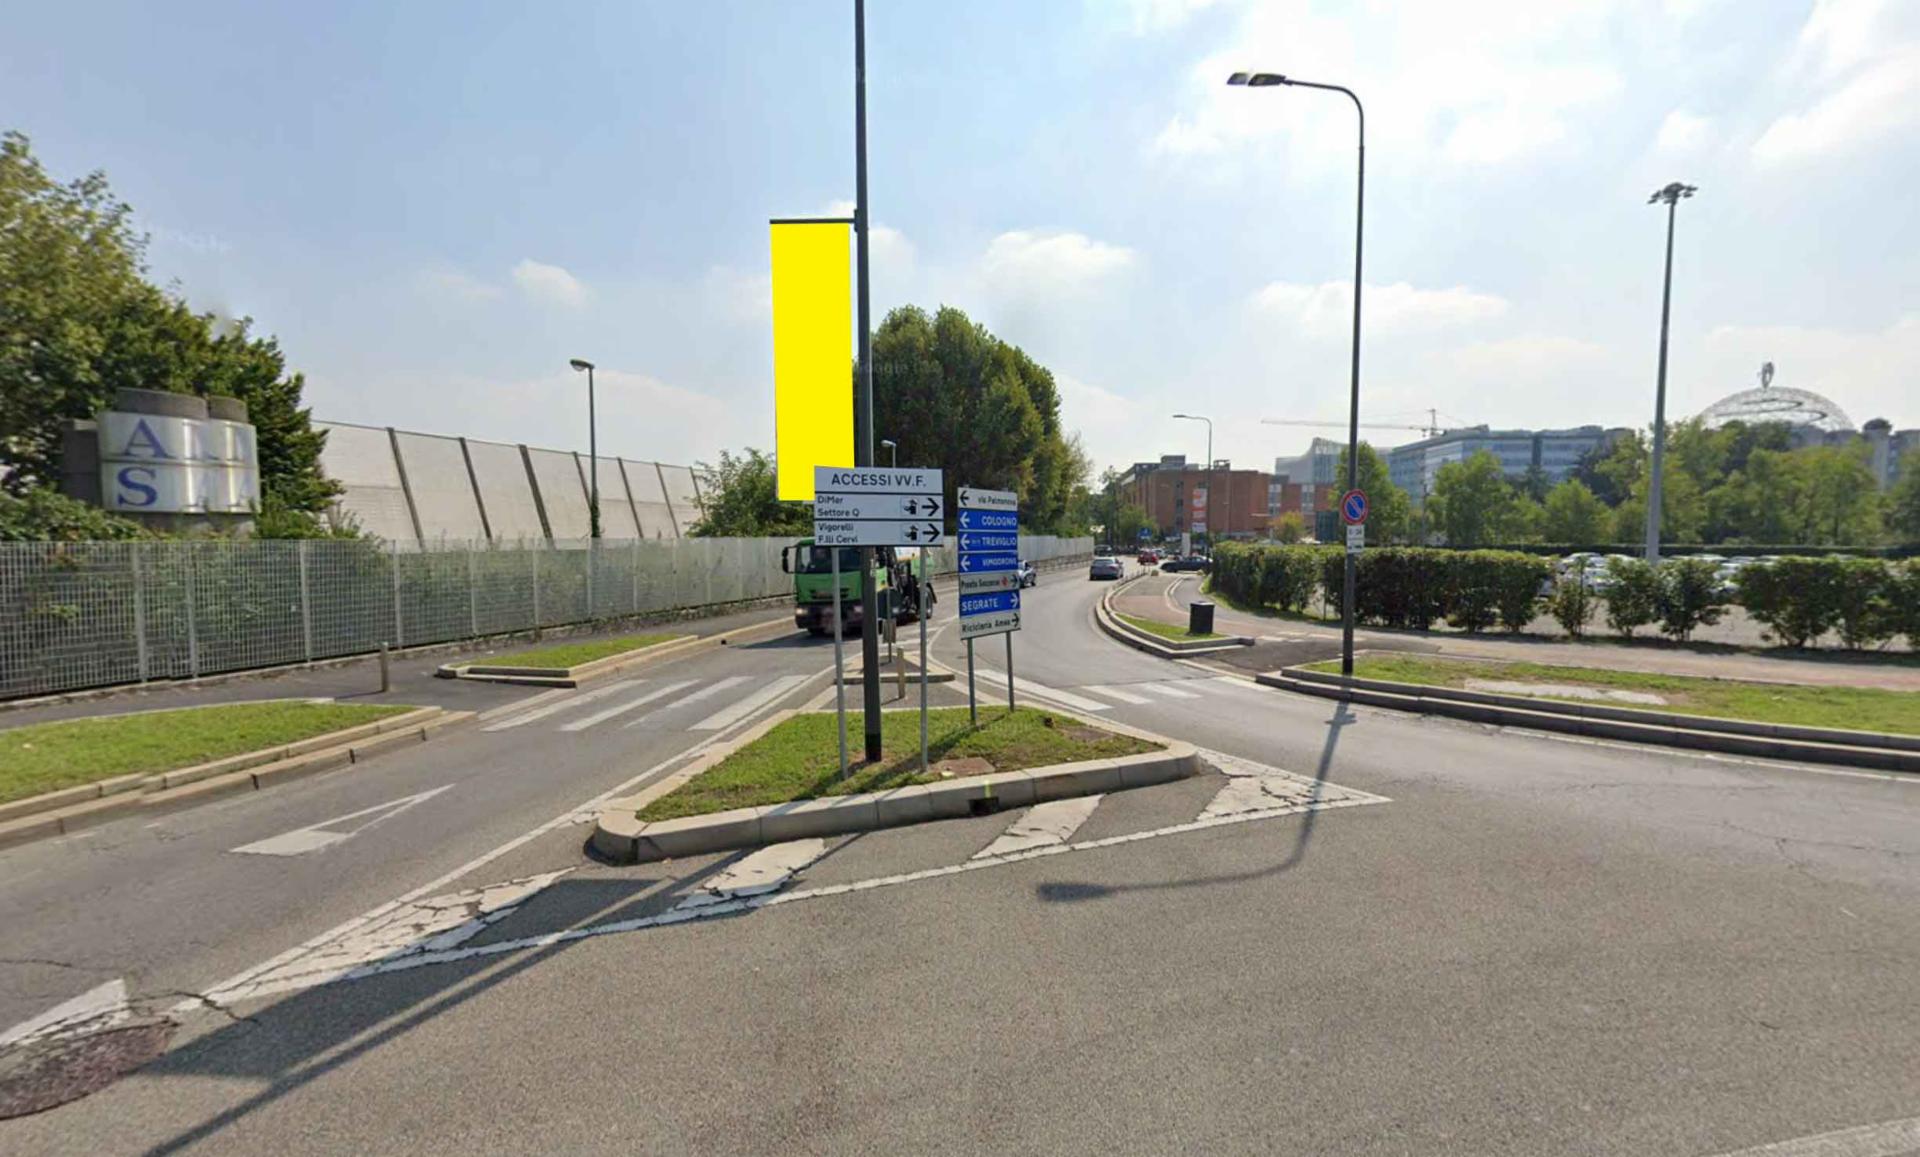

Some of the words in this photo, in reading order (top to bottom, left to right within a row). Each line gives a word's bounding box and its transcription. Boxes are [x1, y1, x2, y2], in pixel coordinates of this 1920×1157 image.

[831, 473, 891, 486] ACCESSI
[817, 508, 850, 517] Settore
[852, 508, 860, 517] Q
[981, 516, 1017, 527] COLOGNO
[818, 523, 854, 533] Vigorelli
[836, 535, 858, 544] Cervi
[982, 536, 1017, 547] TREVIGLIO
[982, 557, 1017, 567] VIMODRONE
[962, 598, 998, 611] SEGRATE
